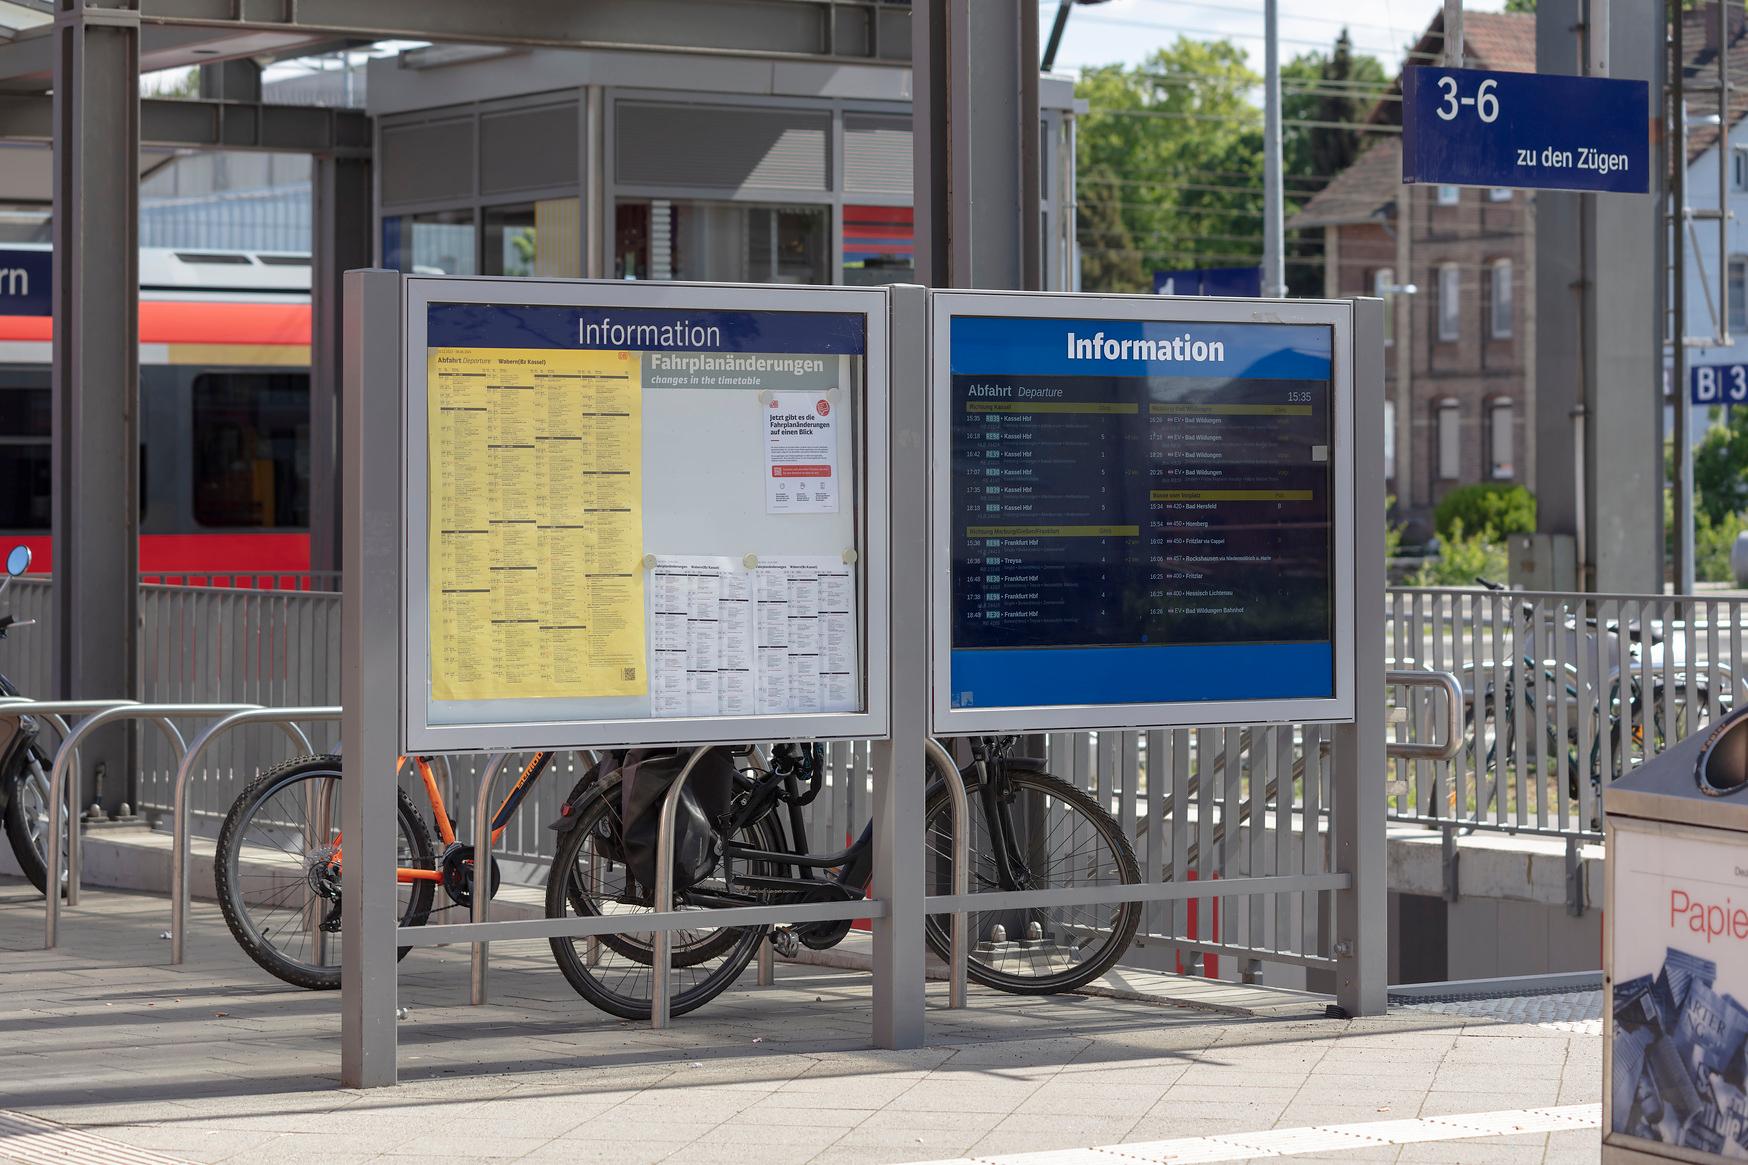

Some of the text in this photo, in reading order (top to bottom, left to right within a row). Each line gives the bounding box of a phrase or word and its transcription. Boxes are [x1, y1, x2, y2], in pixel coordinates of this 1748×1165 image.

[1435, 75, 1500, 124] 3-6
[1517, 146, 1629, 174] zu den Zügen
[579, 317, 720, 347] Information
[1067, 332, 1225, 362] Information
[651, 354, 824, 376] Fahrplanänderungen
[651, 375, 761, 386] changes in the timetable
[1697, 366, 1716, 401] B
[1729, 365, 1746, 400] 3
[968, 384, 1064, 399] Abfahrt Departure
[1287, 391, 1312, 402] 15:35
[769, 414, 784, 422] Jetzt
[784, 414, 797, 422] gibt
[770, 421, 830, 429] Fahrplanänderungen
[1195, 417, 1222, 425] Wildungen
[1195, 434, 1222, 442] Wildungen
[1195, 469, 1222, 477] Wildungen
